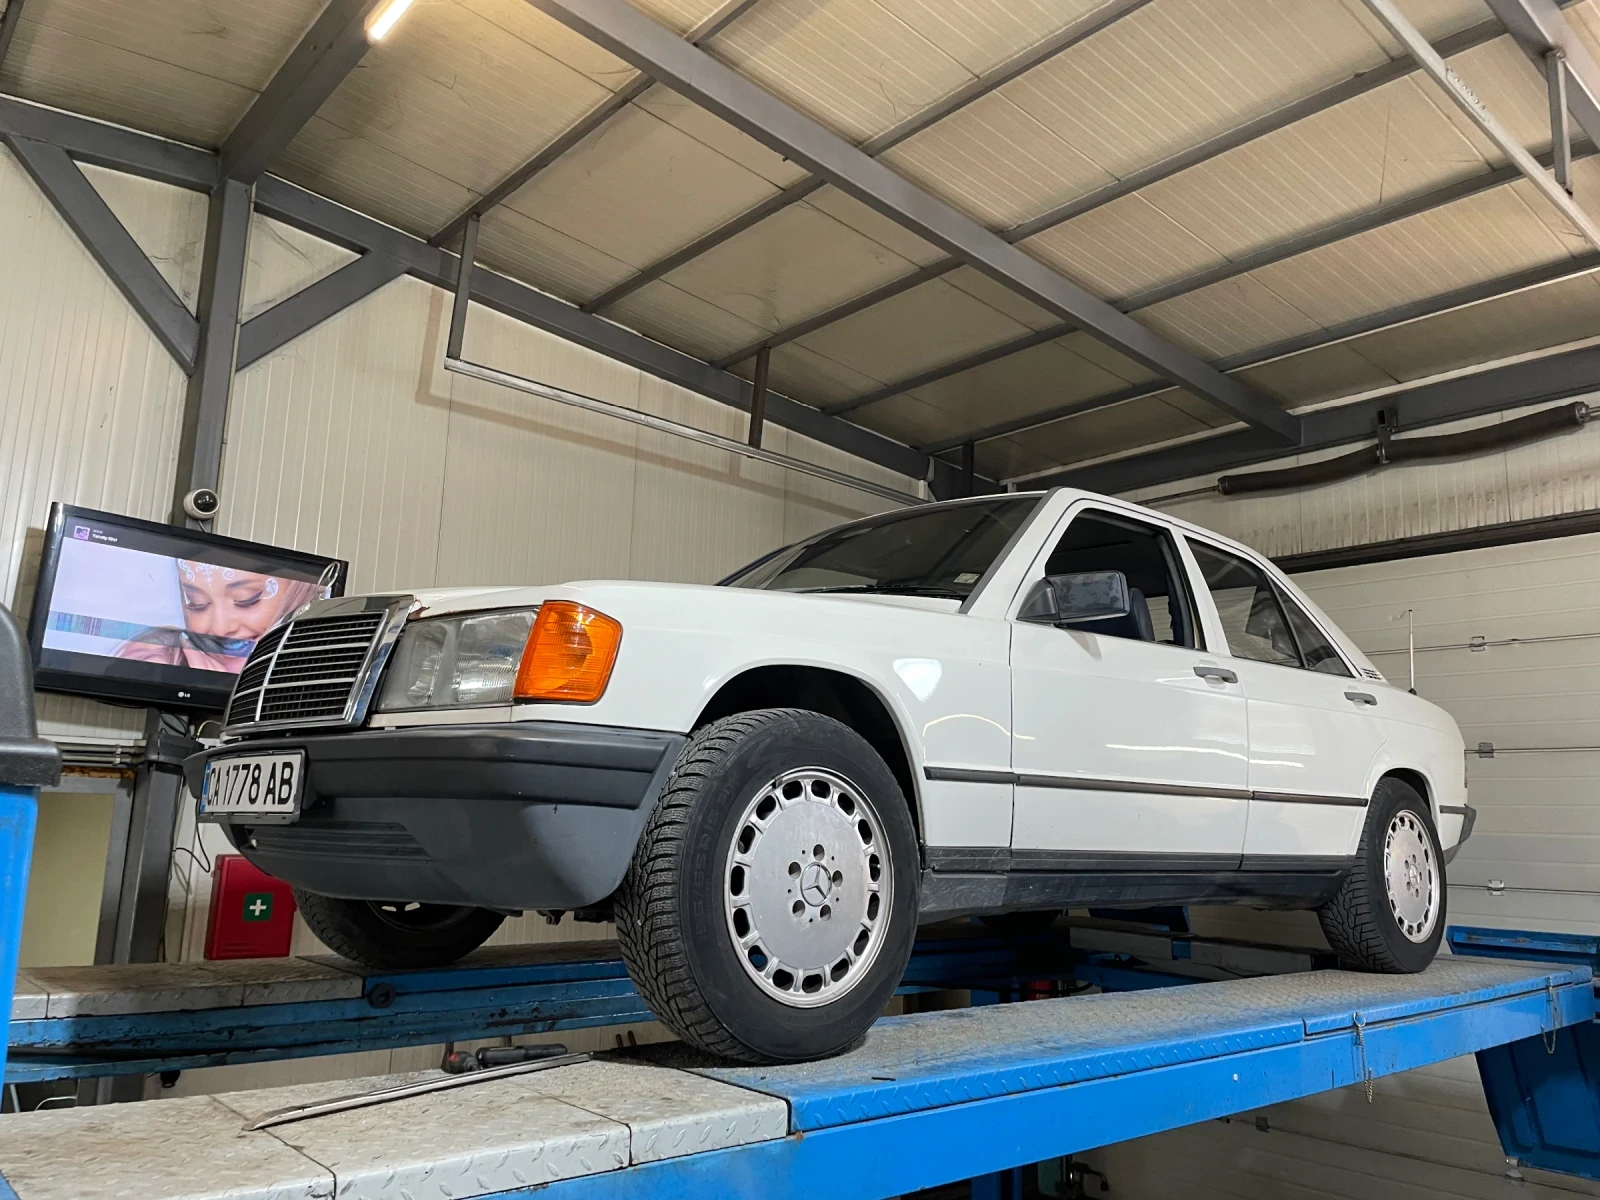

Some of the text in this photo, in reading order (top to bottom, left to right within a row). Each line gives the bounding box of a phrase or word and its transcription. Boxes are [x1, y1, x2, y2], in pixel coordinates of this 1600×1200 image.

[207, 761, 294, 806] CA 1778 AB
